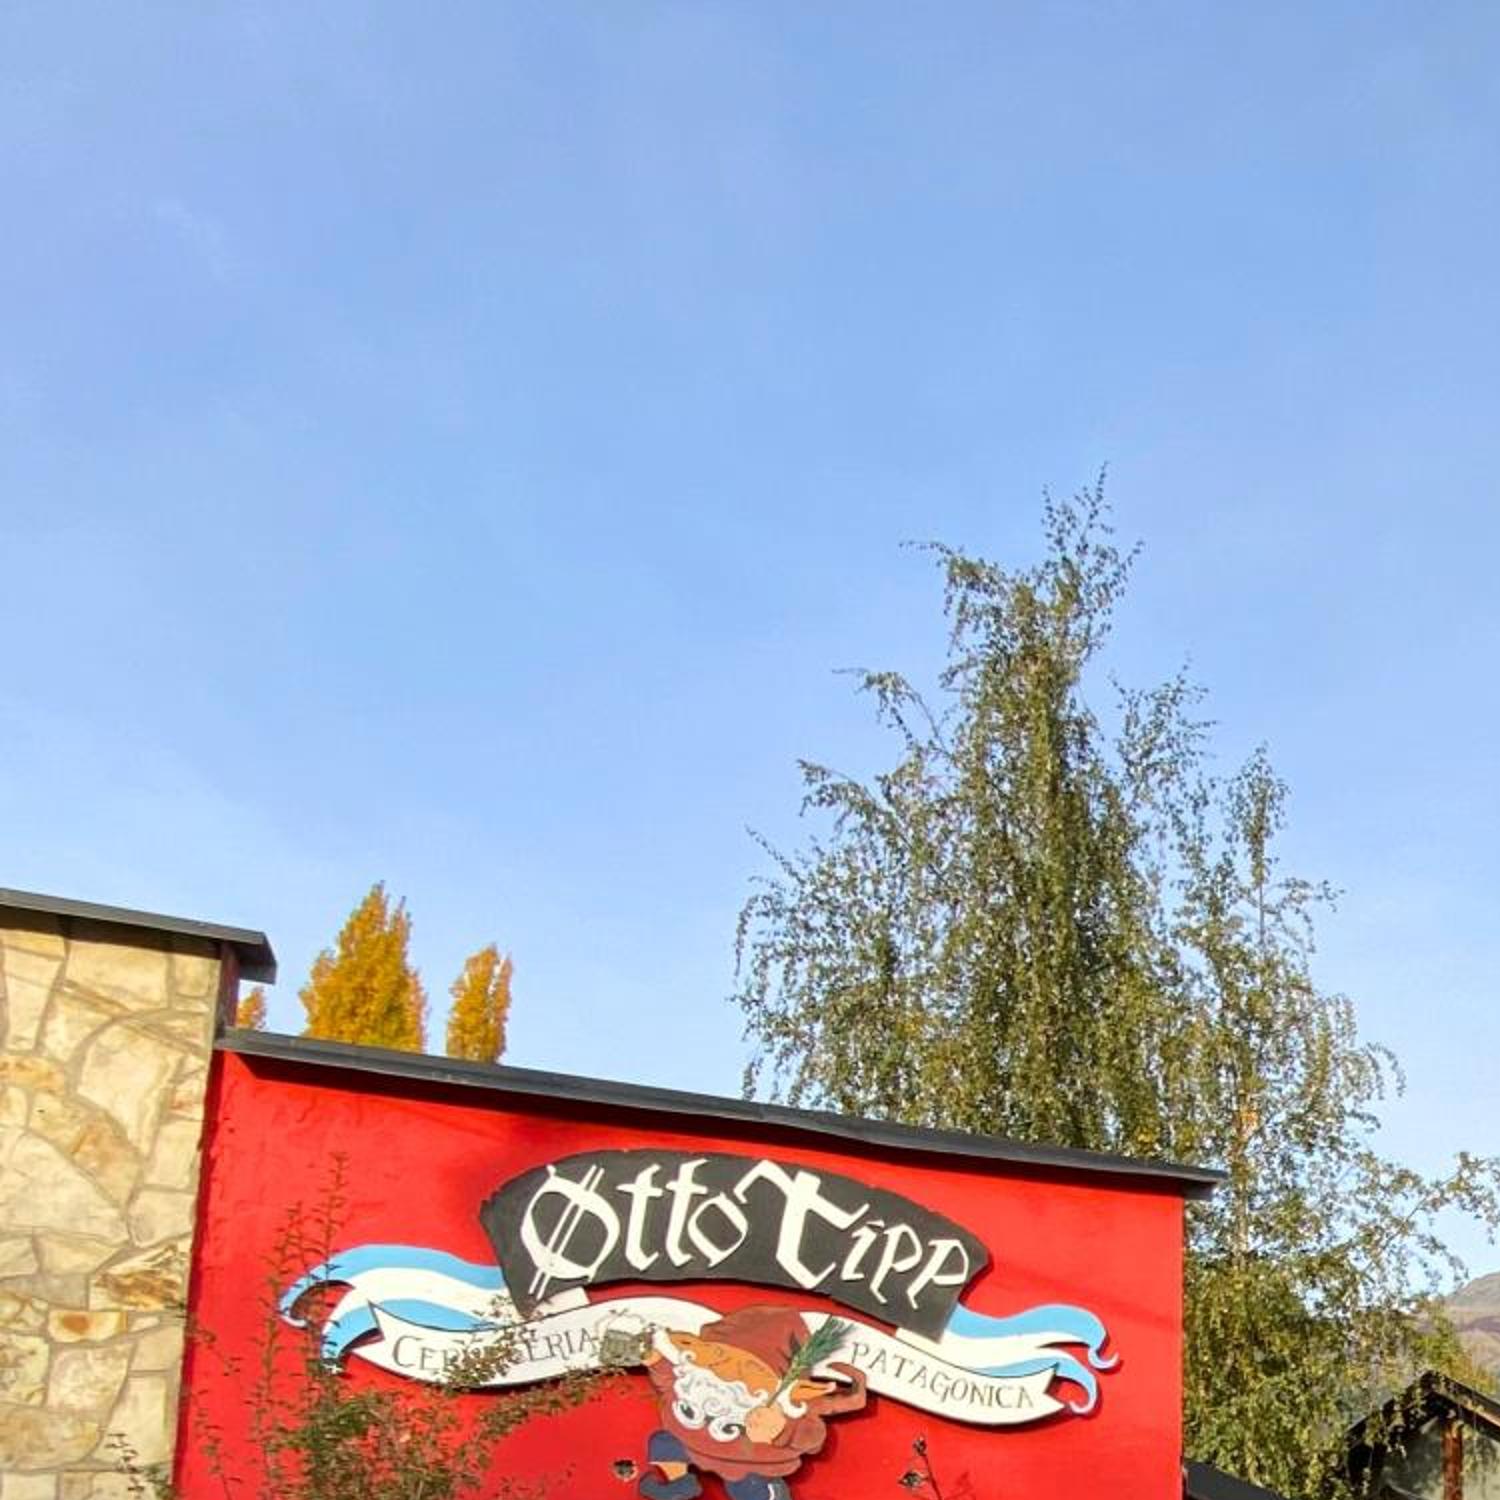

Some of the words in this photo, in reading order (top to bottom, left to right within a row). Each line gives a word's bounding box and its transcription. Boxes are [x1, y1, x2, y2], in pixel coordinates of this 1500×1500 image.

[520, 1158, 749, 1299] Otto
[733, 1159, 969, 1309] Tipp
[392, 1328, 597, 1372] CERERIA
[851, 1341, 1034, 1409] PATAGONICA
